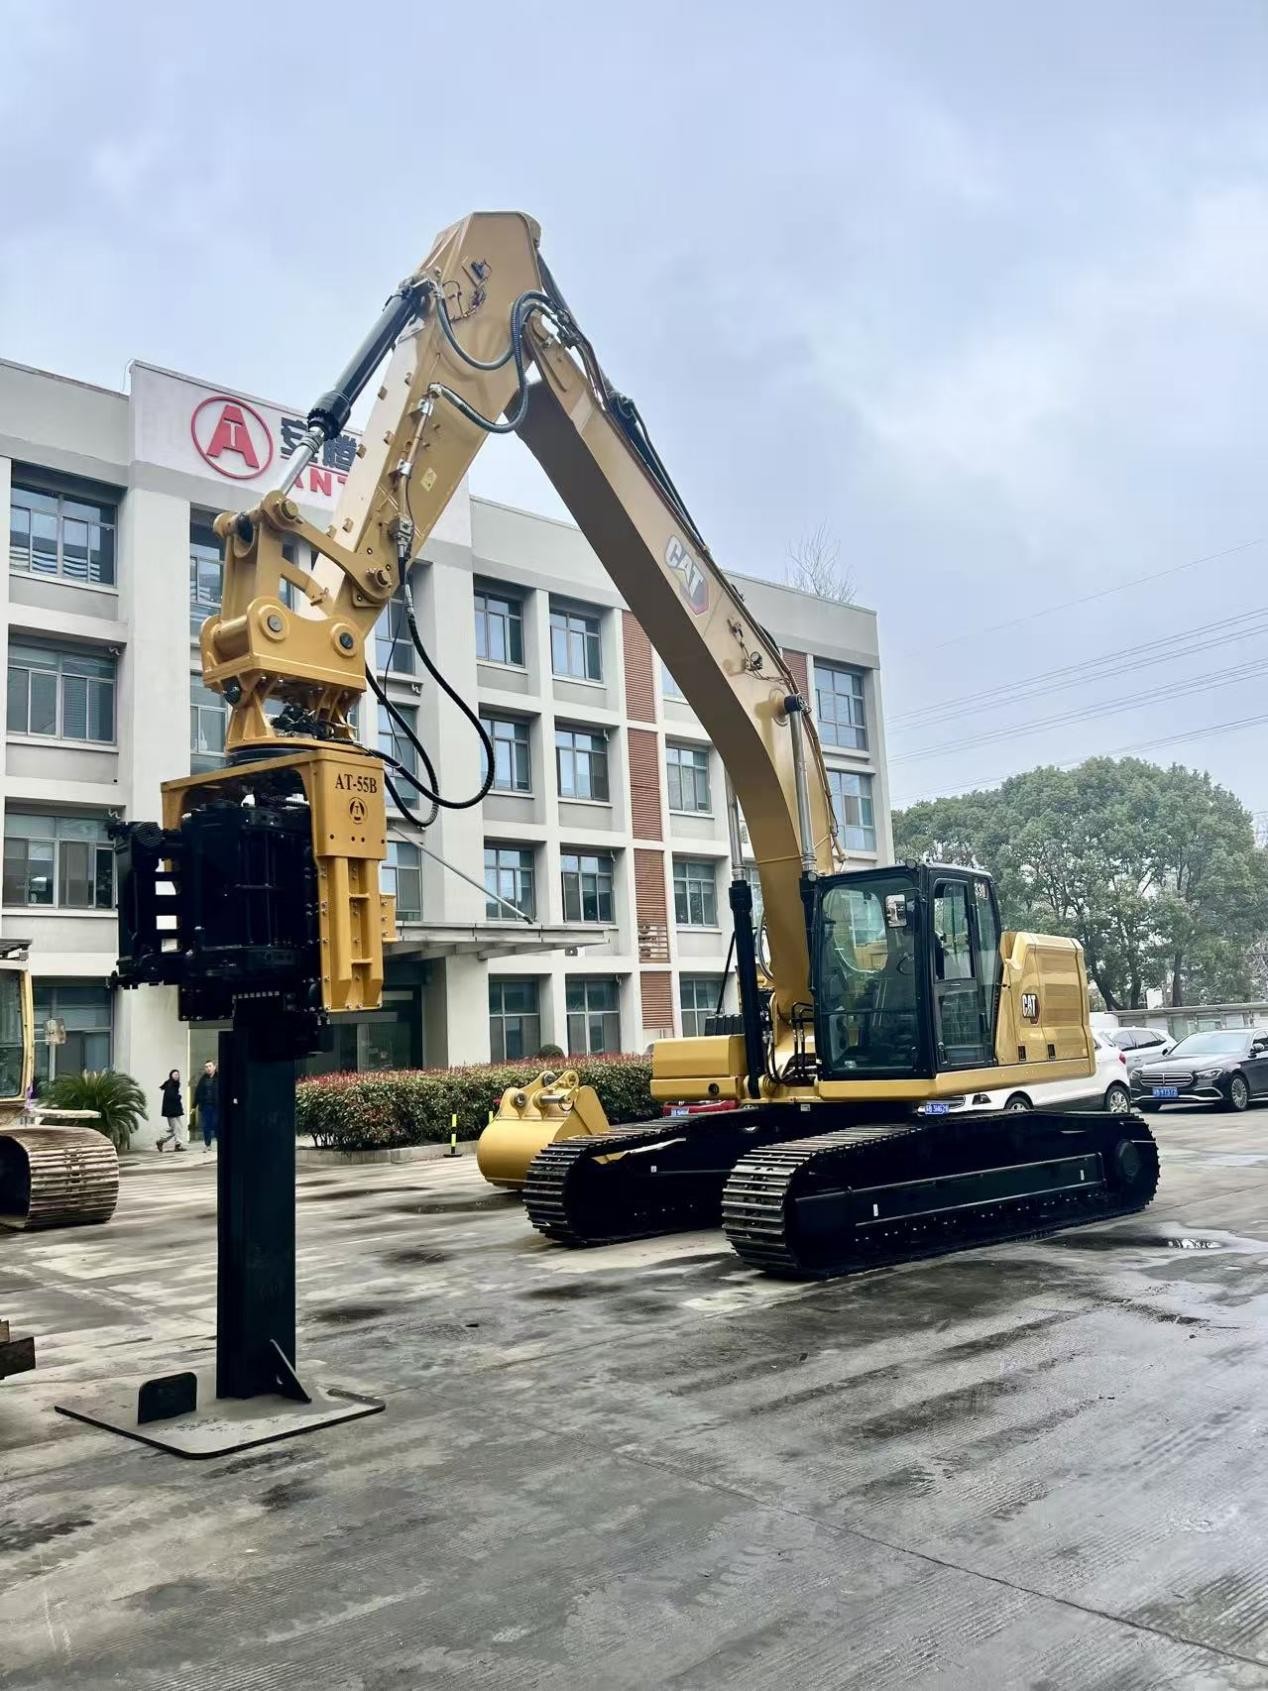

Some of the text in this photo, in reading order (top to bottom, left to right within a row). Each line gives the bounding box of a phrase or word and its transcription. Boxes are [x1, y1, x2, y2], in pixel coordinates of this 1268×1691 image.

[664, 535, 705, 599] CAT
[335, 773, 377, 794] AT-55B
[1022, 994, 1036, 1017] CAT
